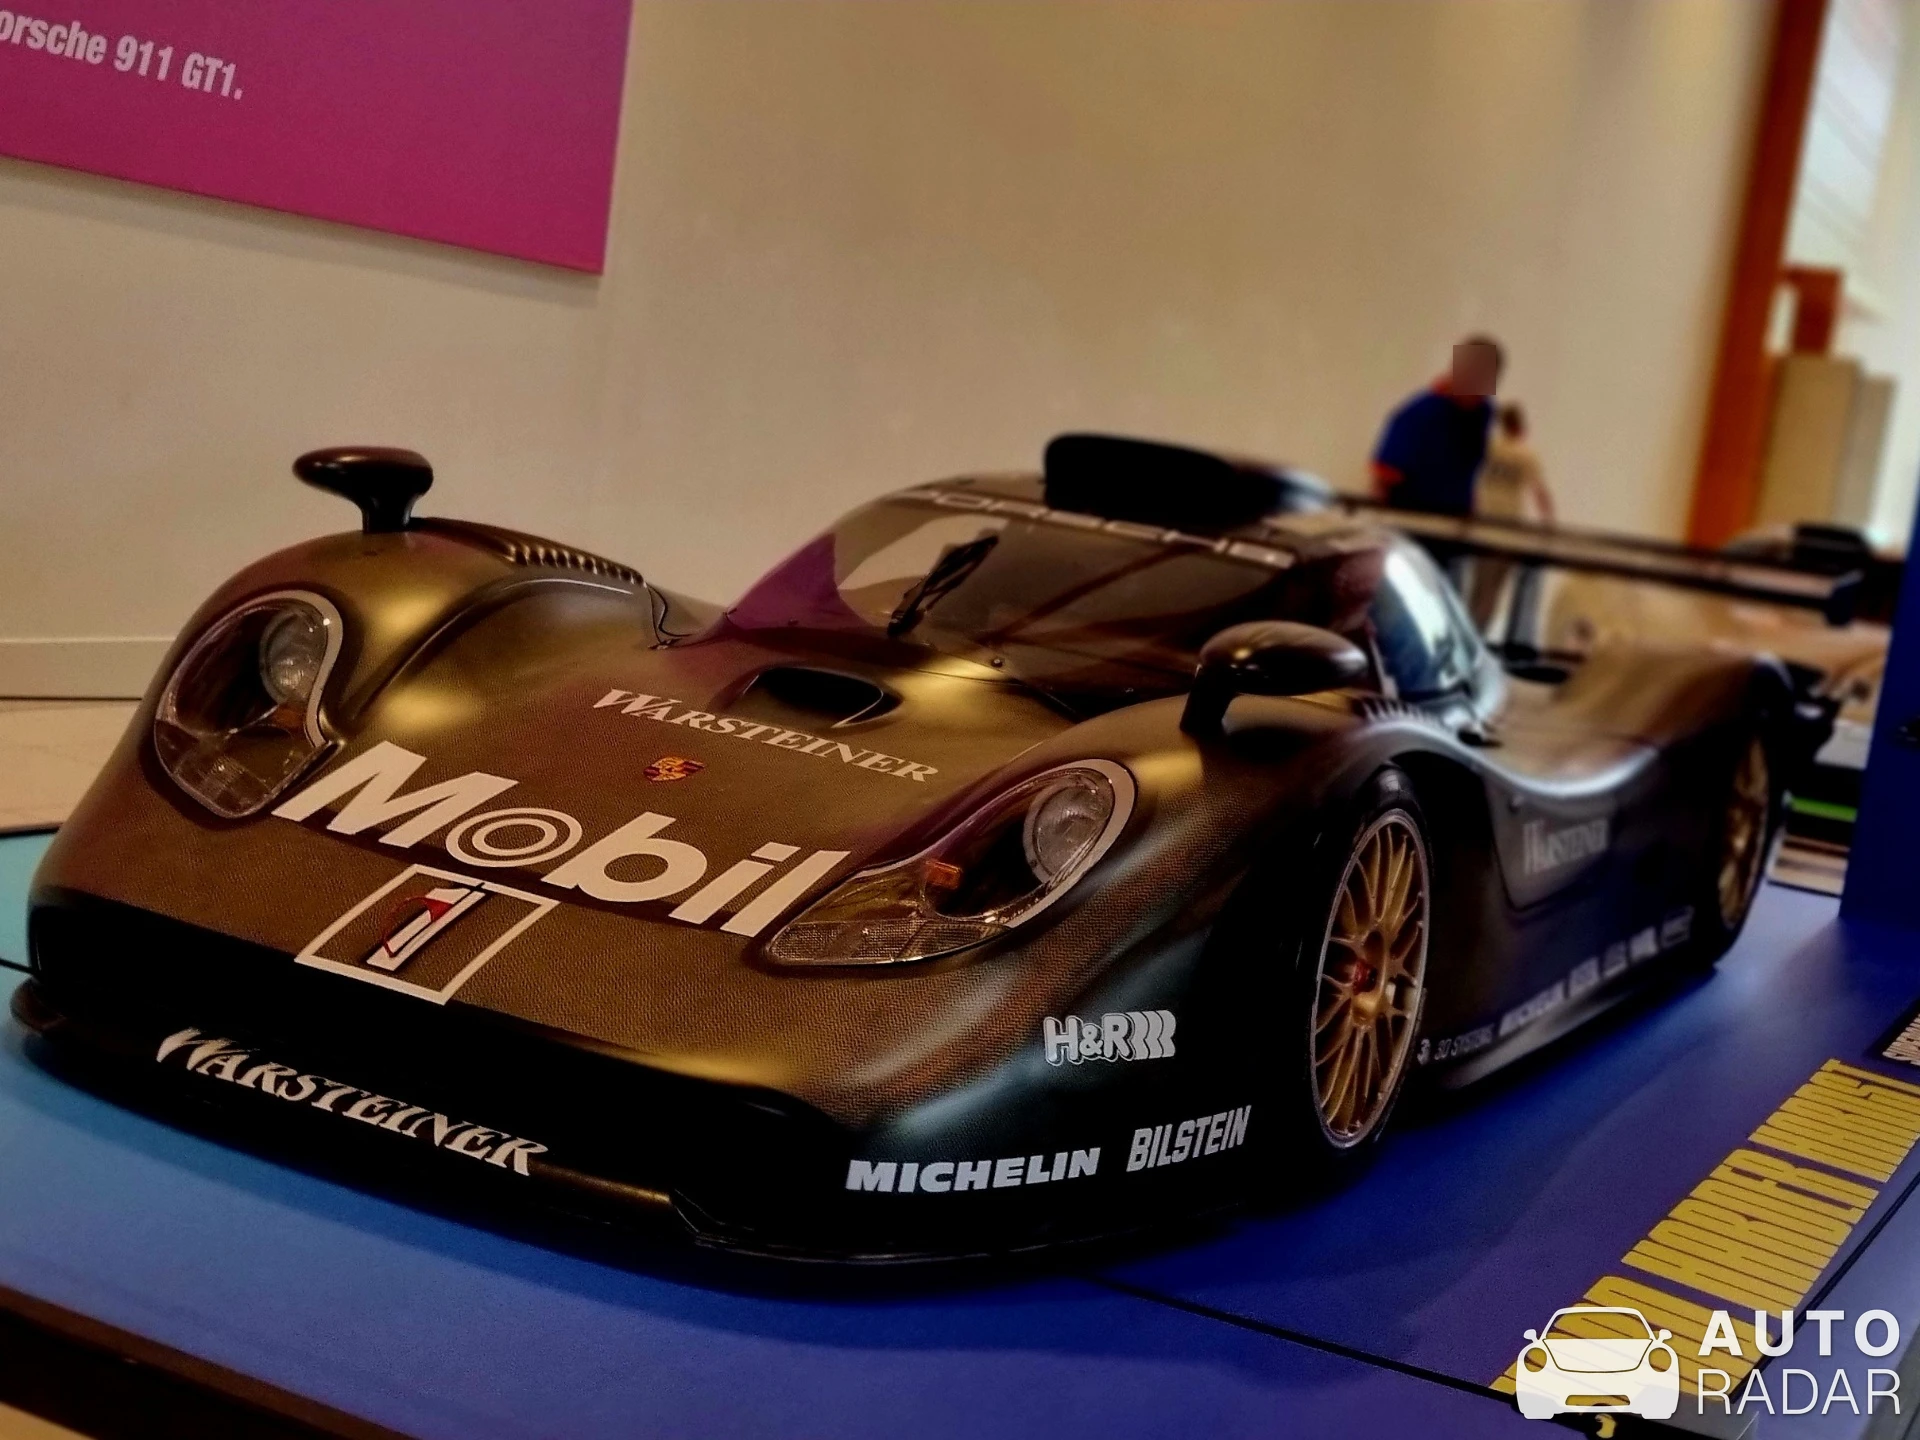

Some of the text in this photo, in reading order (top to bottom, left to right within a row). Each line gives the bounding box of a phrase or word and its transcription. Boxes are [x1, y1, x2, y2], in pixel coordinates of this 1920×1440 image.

[0, 9, 243, 100] orsche 911 GT1.
[593, 689, 939, 782] WARSTEINER
[271, 741, 851, 938] Mobil
[156, 1027, 549, 1176] WARSTEINER
[1126, 1105, 1252, 1172] BILSTEIN
[845, 1147, 1101, 1193] MICHELIN
